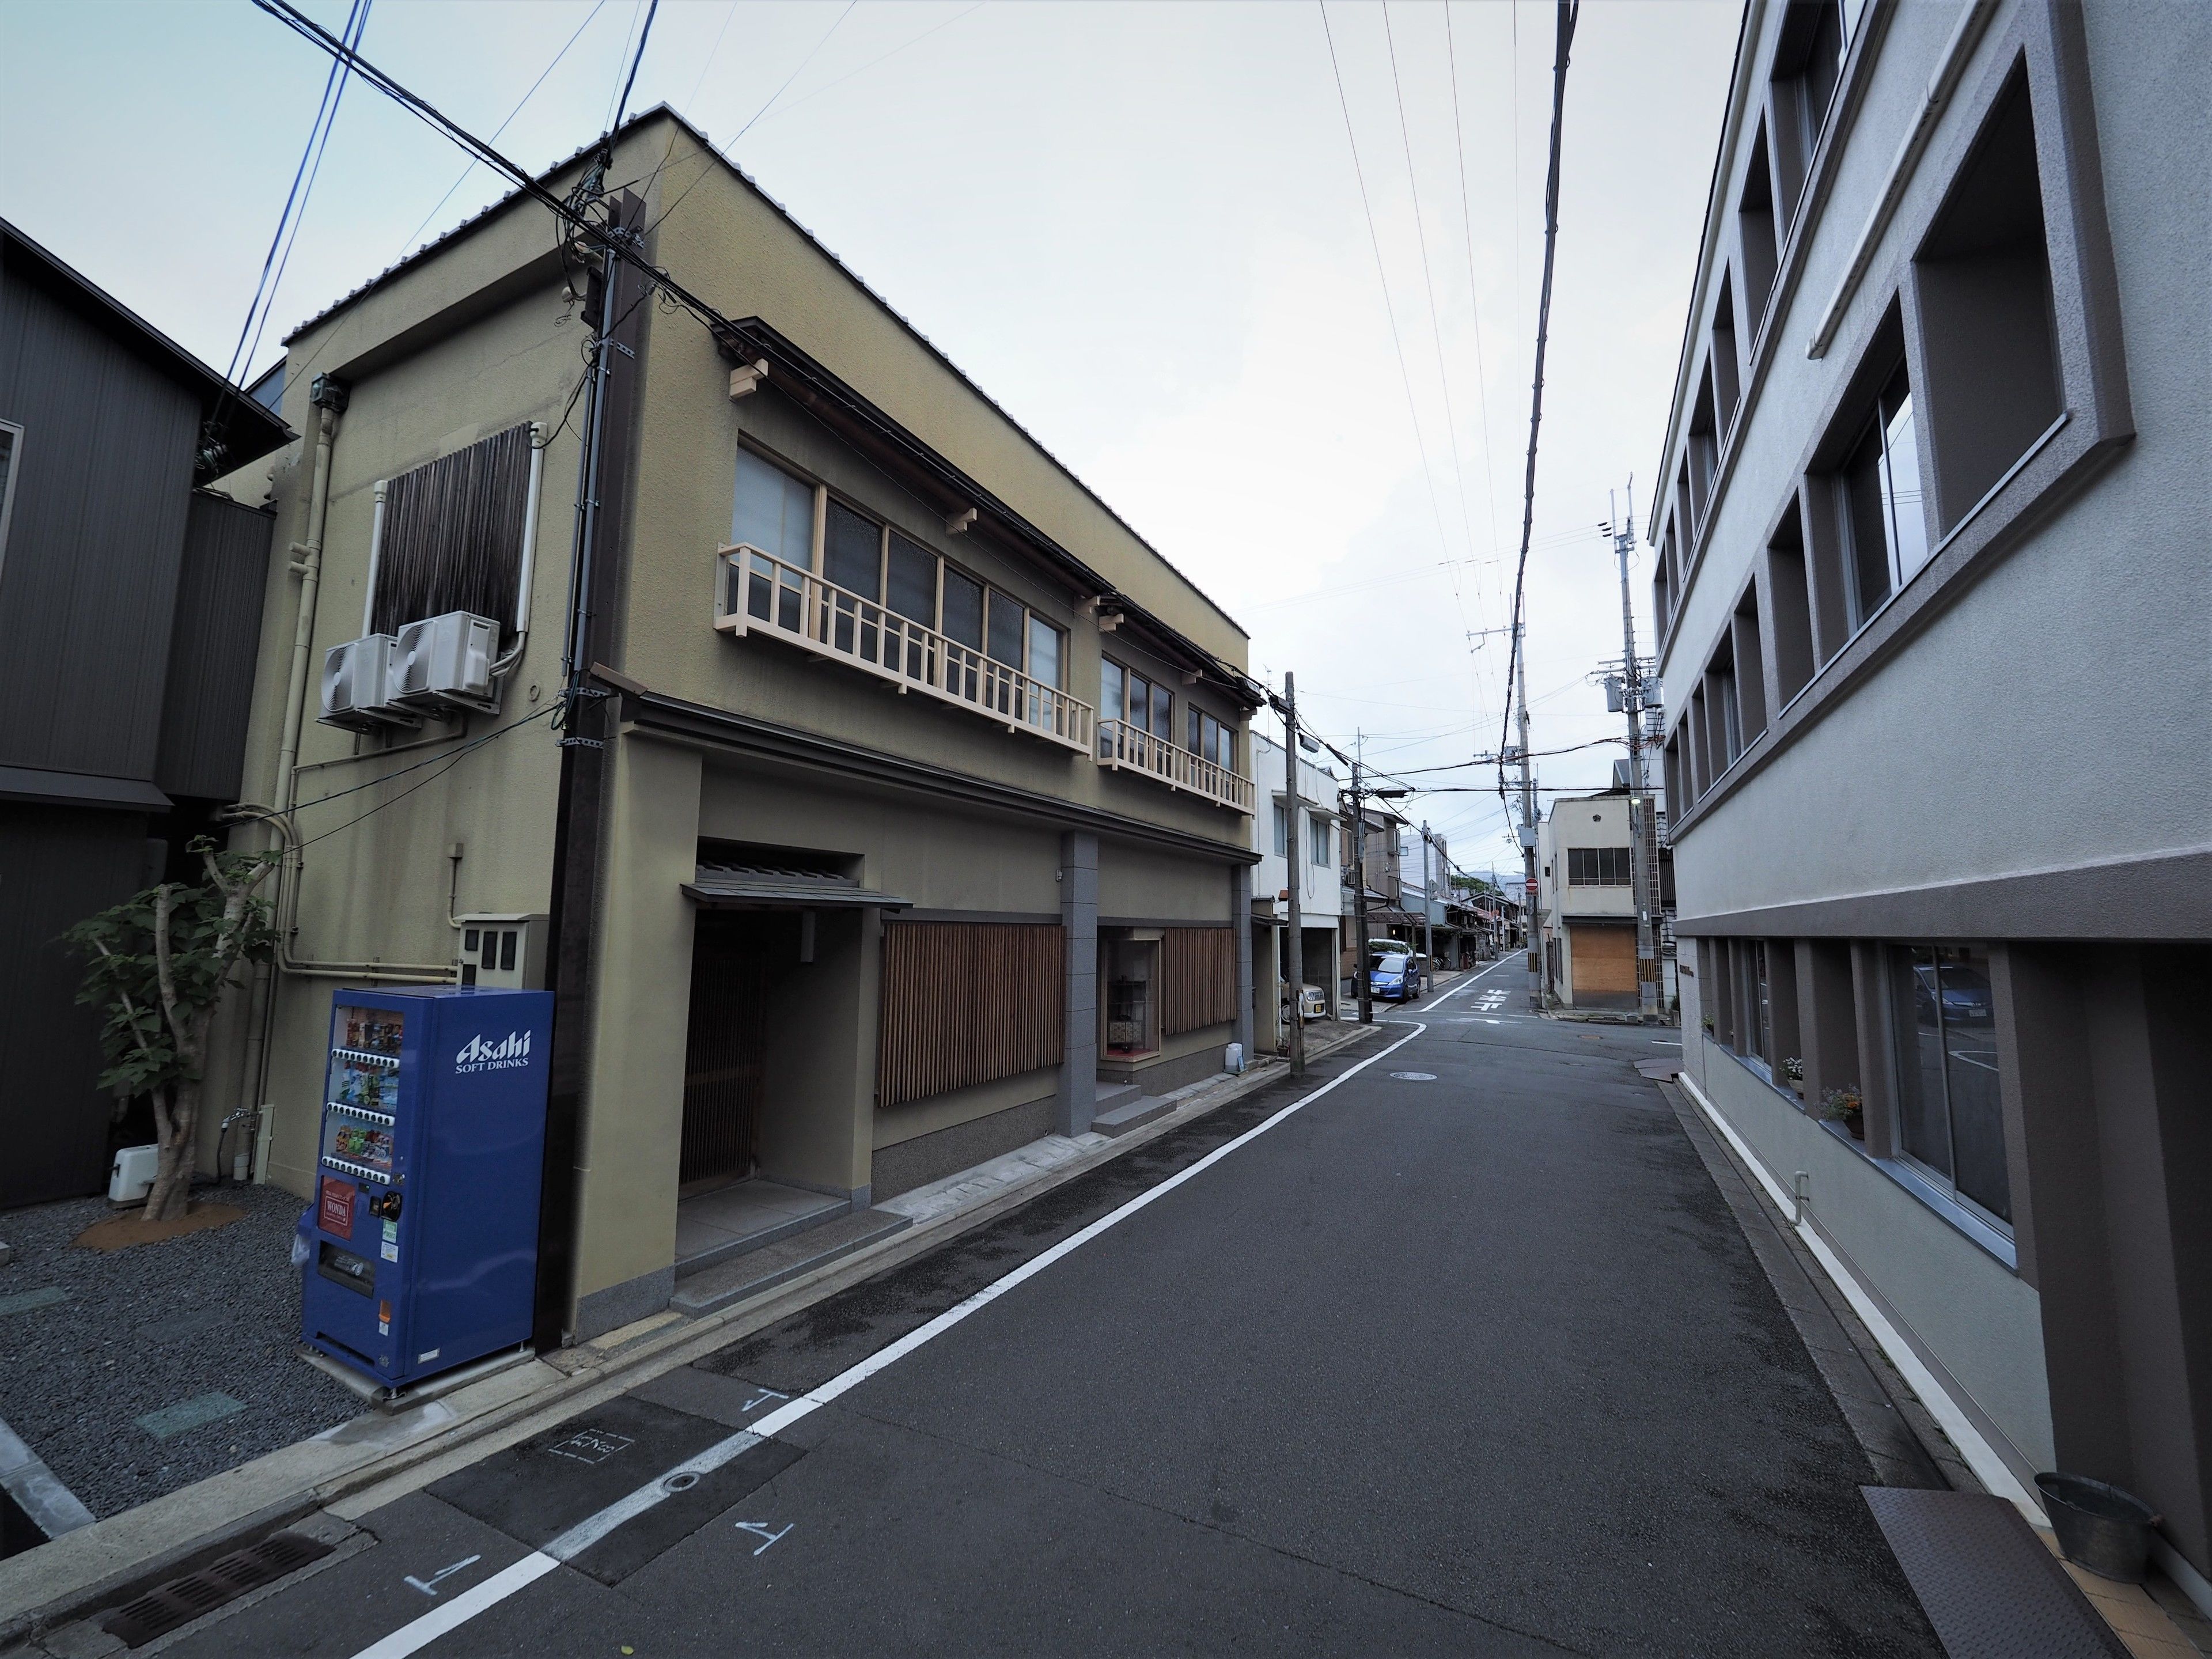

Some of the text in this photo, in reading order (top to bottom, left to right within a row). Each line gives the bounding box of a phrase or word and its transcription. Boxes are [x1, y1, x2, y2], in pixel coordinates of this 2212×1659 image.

[1470, 989, 1512, 1011] 止まれ
[456, 1029, 531, 1064] Asahi
[455, 1058, 529, 1074] SOFT DRINKS
[327, 1200, 346, 1217] WONDA
